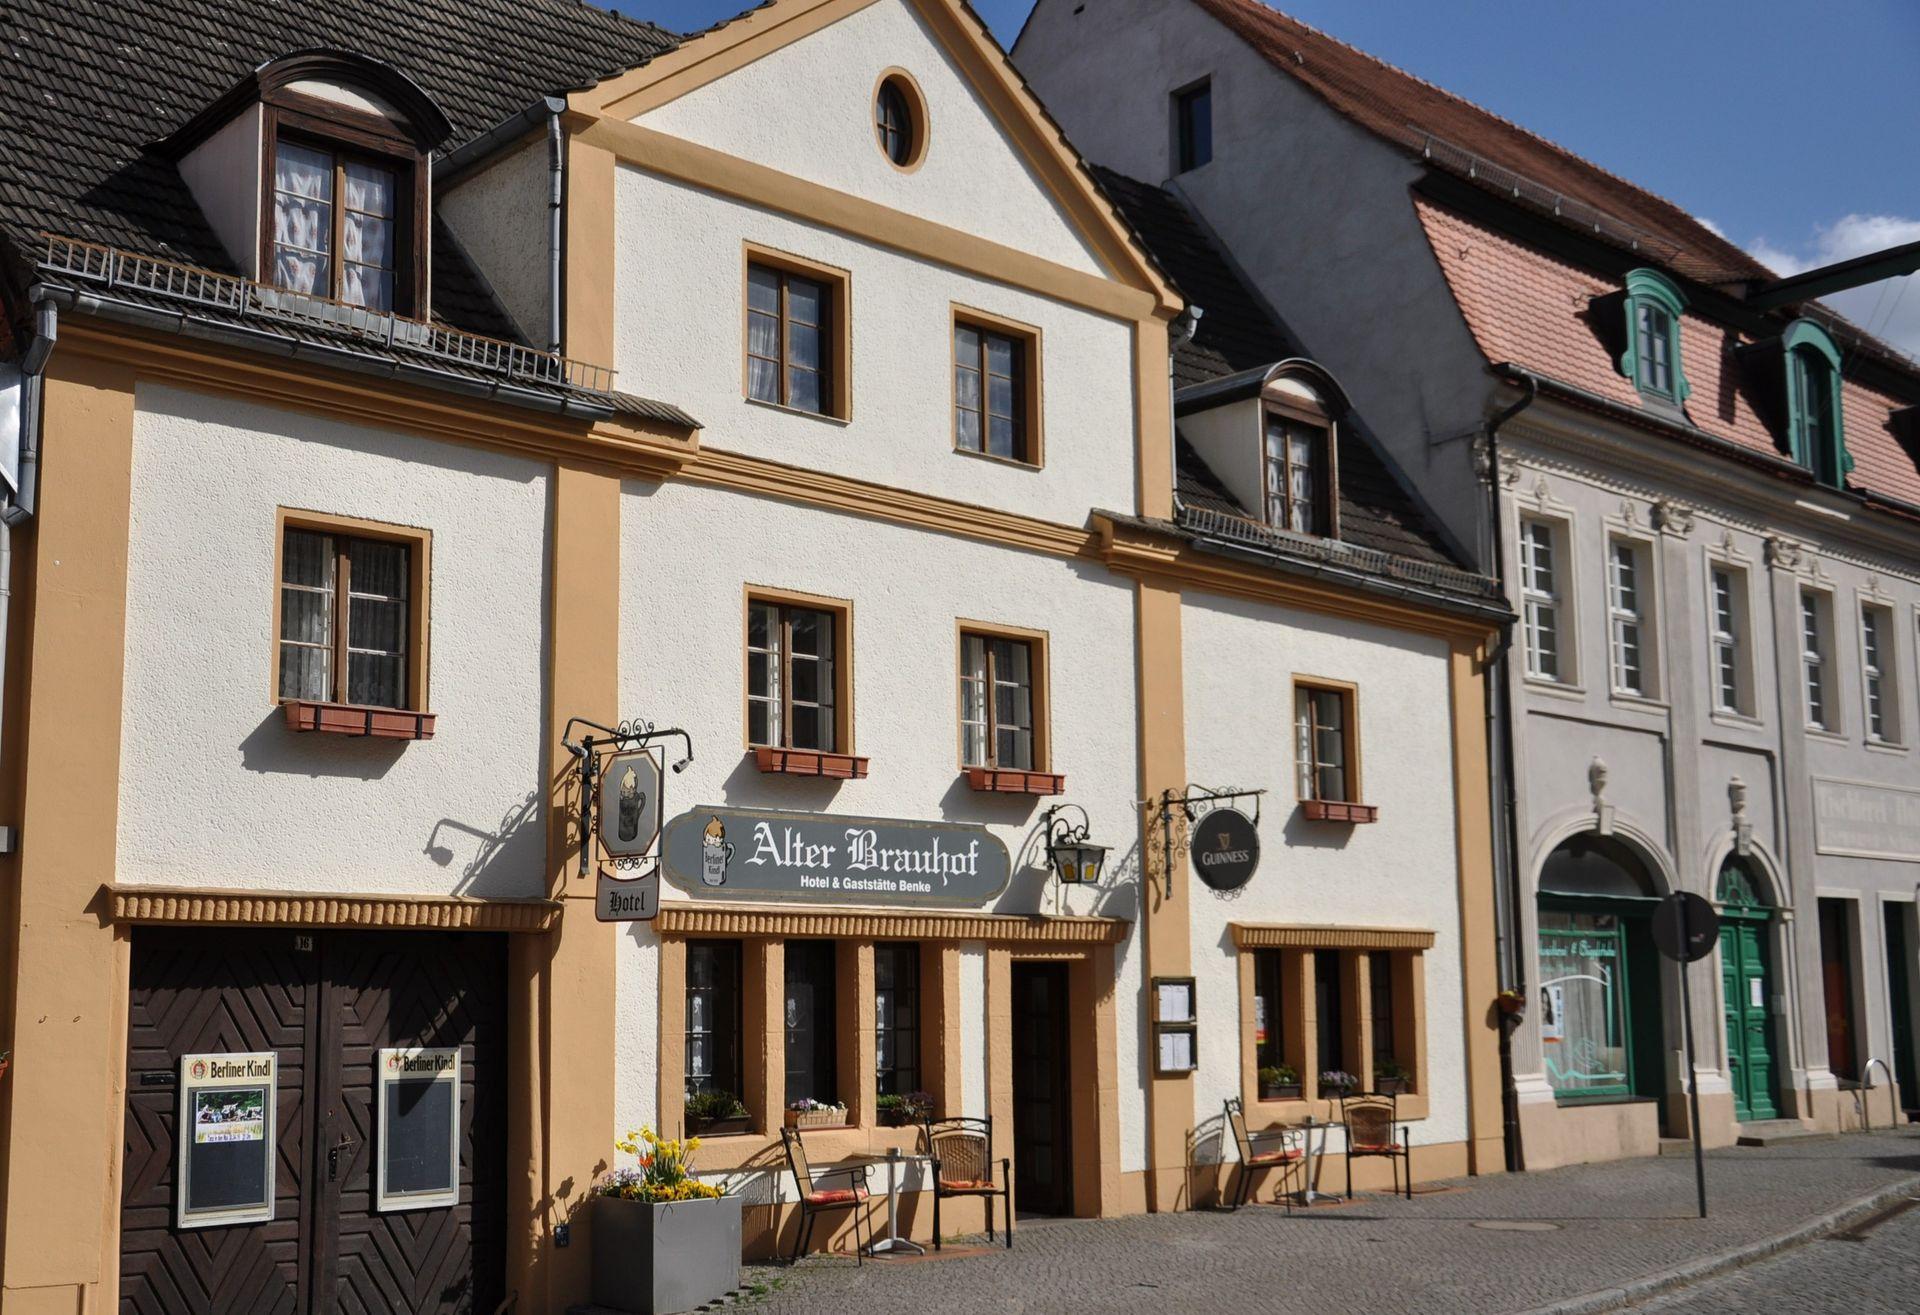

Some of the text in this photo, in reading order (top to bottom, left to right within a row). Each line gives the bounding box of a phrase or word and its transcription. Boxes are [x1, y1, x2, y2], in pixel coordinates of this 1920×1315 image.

[744, 821, 980, 887] Alter Brauhof
[1202, 850, 1249, 866] GUINNESS
[800, 875, 931, 892] Hotel & Gaststätte Benke
[608, 891, 645, 916] Hotel
[211, 1060, 270, 1078] Berliner Kindl
[404, 1055, 455, 1072] Berliner Kindl
